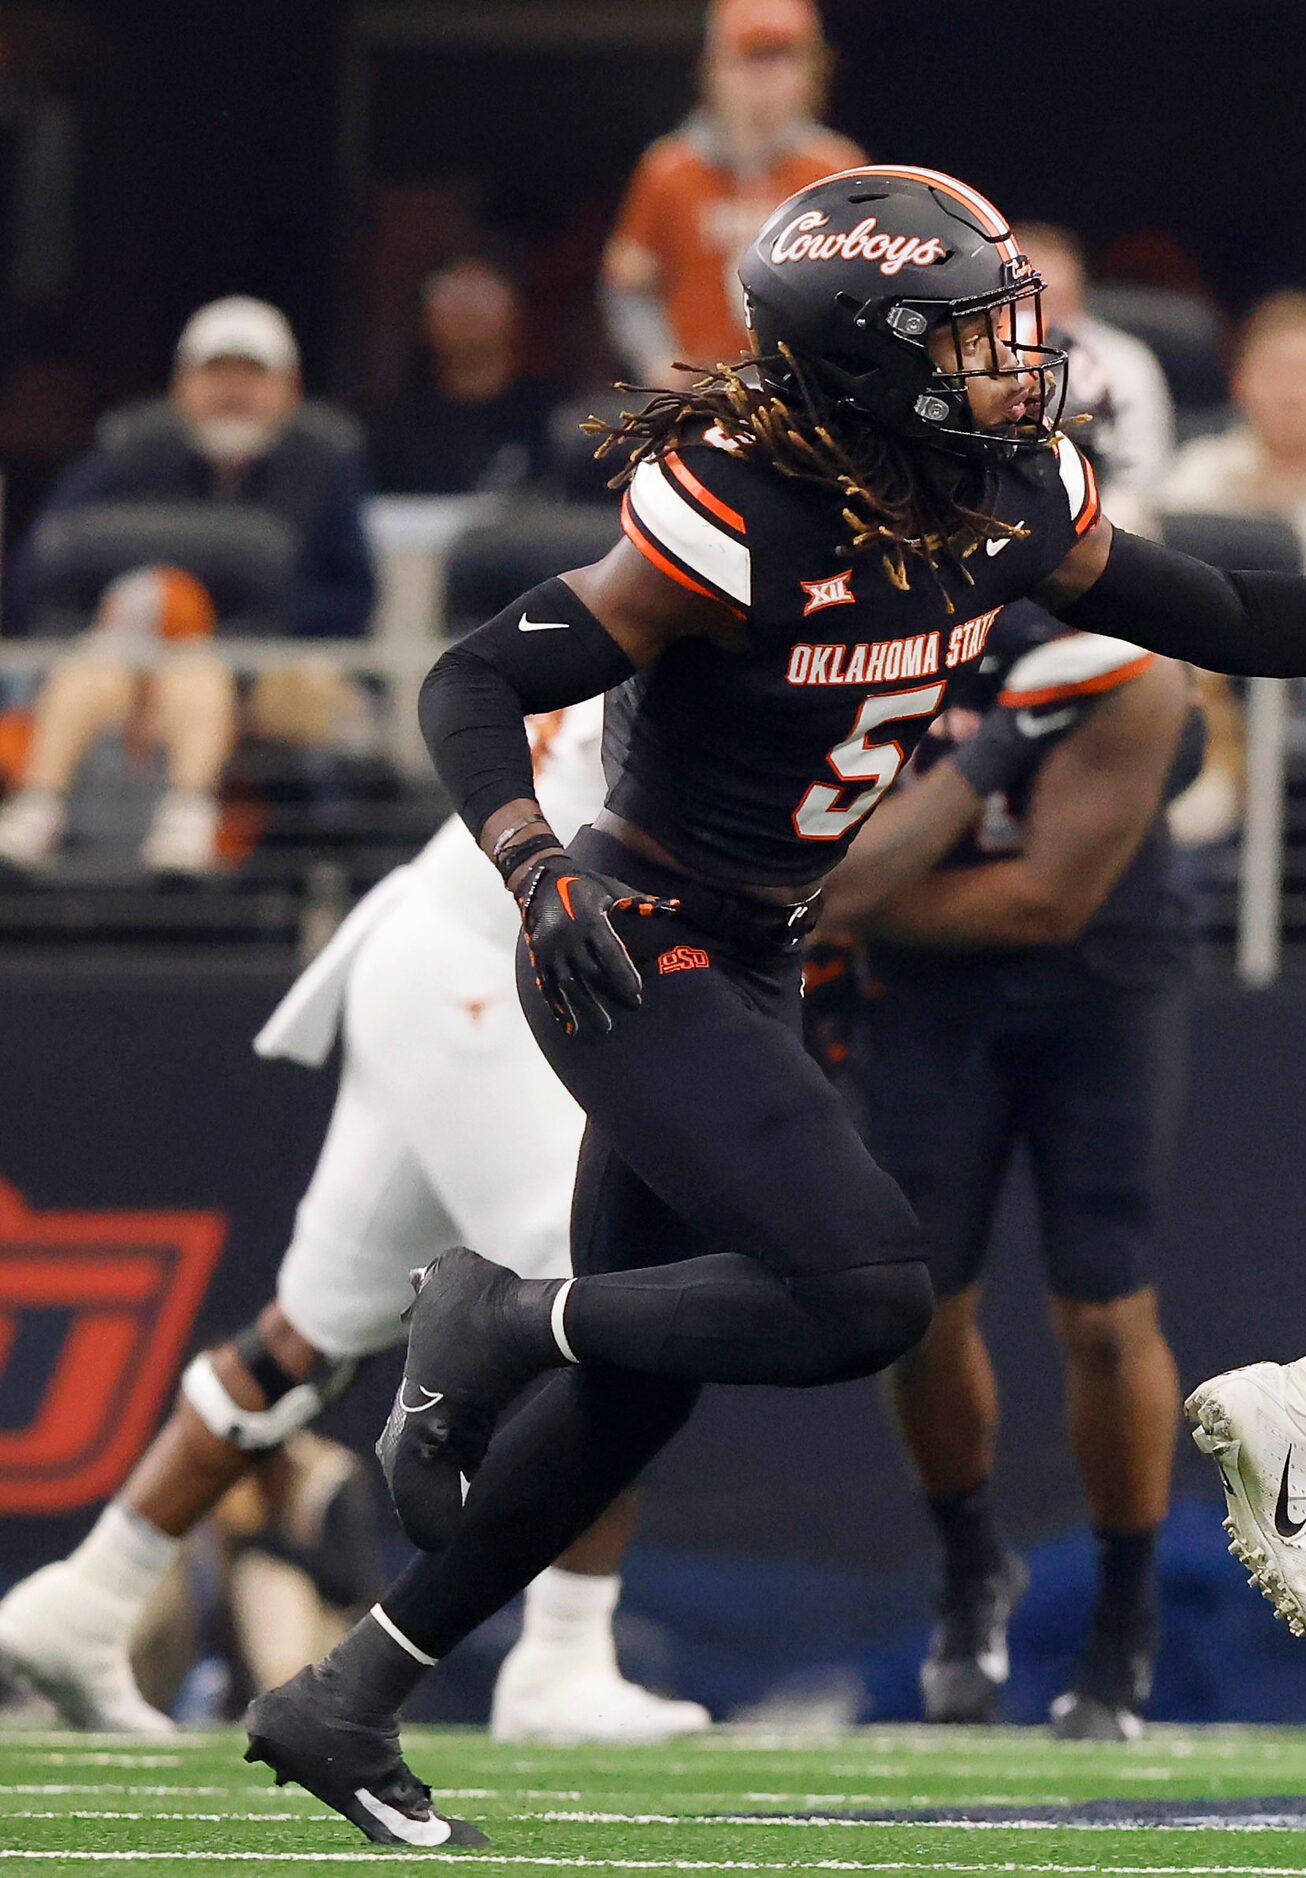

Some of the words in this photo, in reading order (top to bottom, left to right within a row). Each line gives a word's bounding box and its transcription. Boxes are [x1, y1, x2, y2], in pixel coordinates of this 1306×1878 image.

[770, 209, 947, 276] Cowboys
[785, 631, 941, 686] OKLAHOMA
[792, 680, 947, 840] 5
[658, 945, 710, 975] OSU
